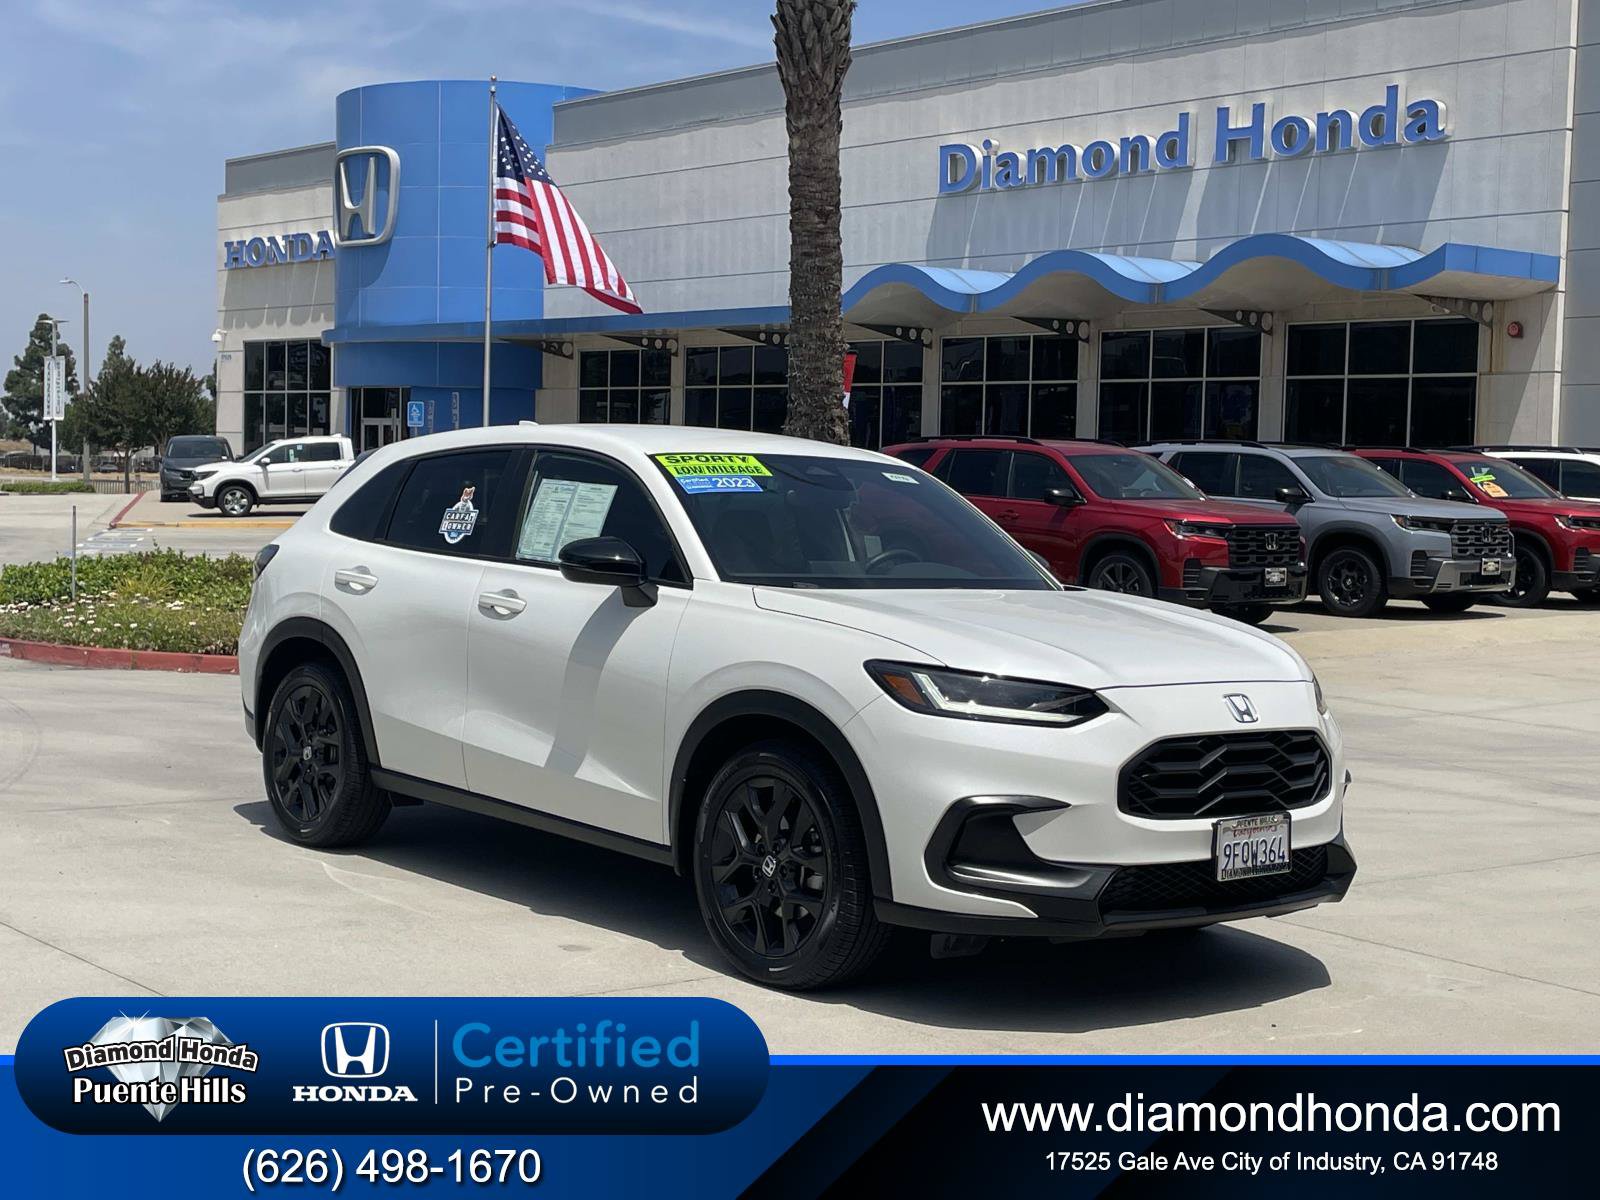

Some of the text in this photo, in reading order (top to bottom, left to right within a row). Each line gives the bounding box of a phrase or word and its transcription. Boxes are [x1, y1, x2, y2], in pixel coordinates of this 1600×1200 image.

[938, 84, 1446, 194] Diamond Honda
[224, 230, 336, 269] HONDA
[664, 454, 750, 464] SPORTY
[673, 465, 764, 475] LOW MILEAGE
[711, 477, 755, 488] 2023
[1223, 836, 1286, 869] 9FQW364
